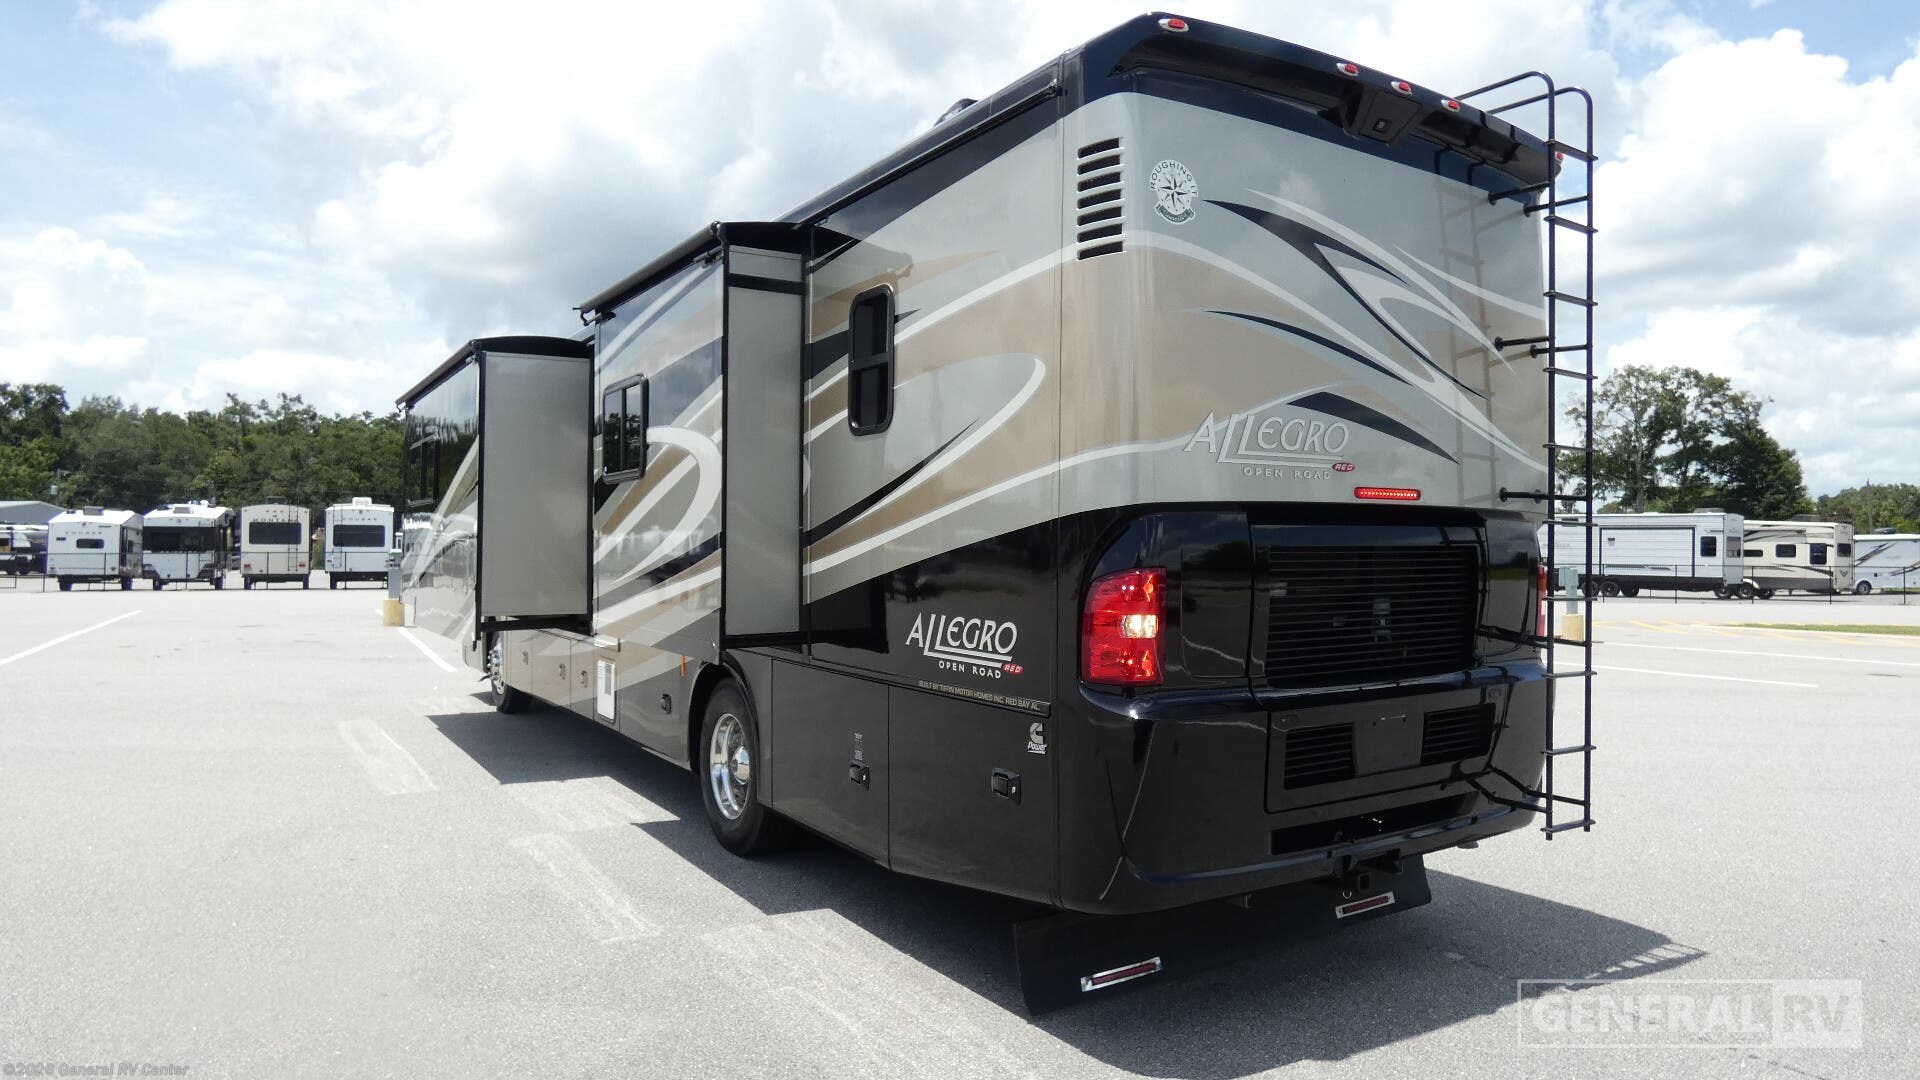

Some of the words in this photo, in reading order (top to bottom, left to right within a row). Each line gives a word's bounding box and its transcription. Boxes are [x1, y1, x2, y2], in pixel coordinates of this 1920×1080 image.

[1184, 412, 1350, 466] ALLEGRO
[1242, 467, 1283, 478] OPEN
[1293, 469, 1332, 480] ROAD
[1334, 463, 1354, 472] RED
[905, 612, 1018, 662] ALLEGRO
[938, 660, 965, 673] OPEN
[972, 666, 1001, 679] ROAD
[1004, 664, 1022, 673] RED
